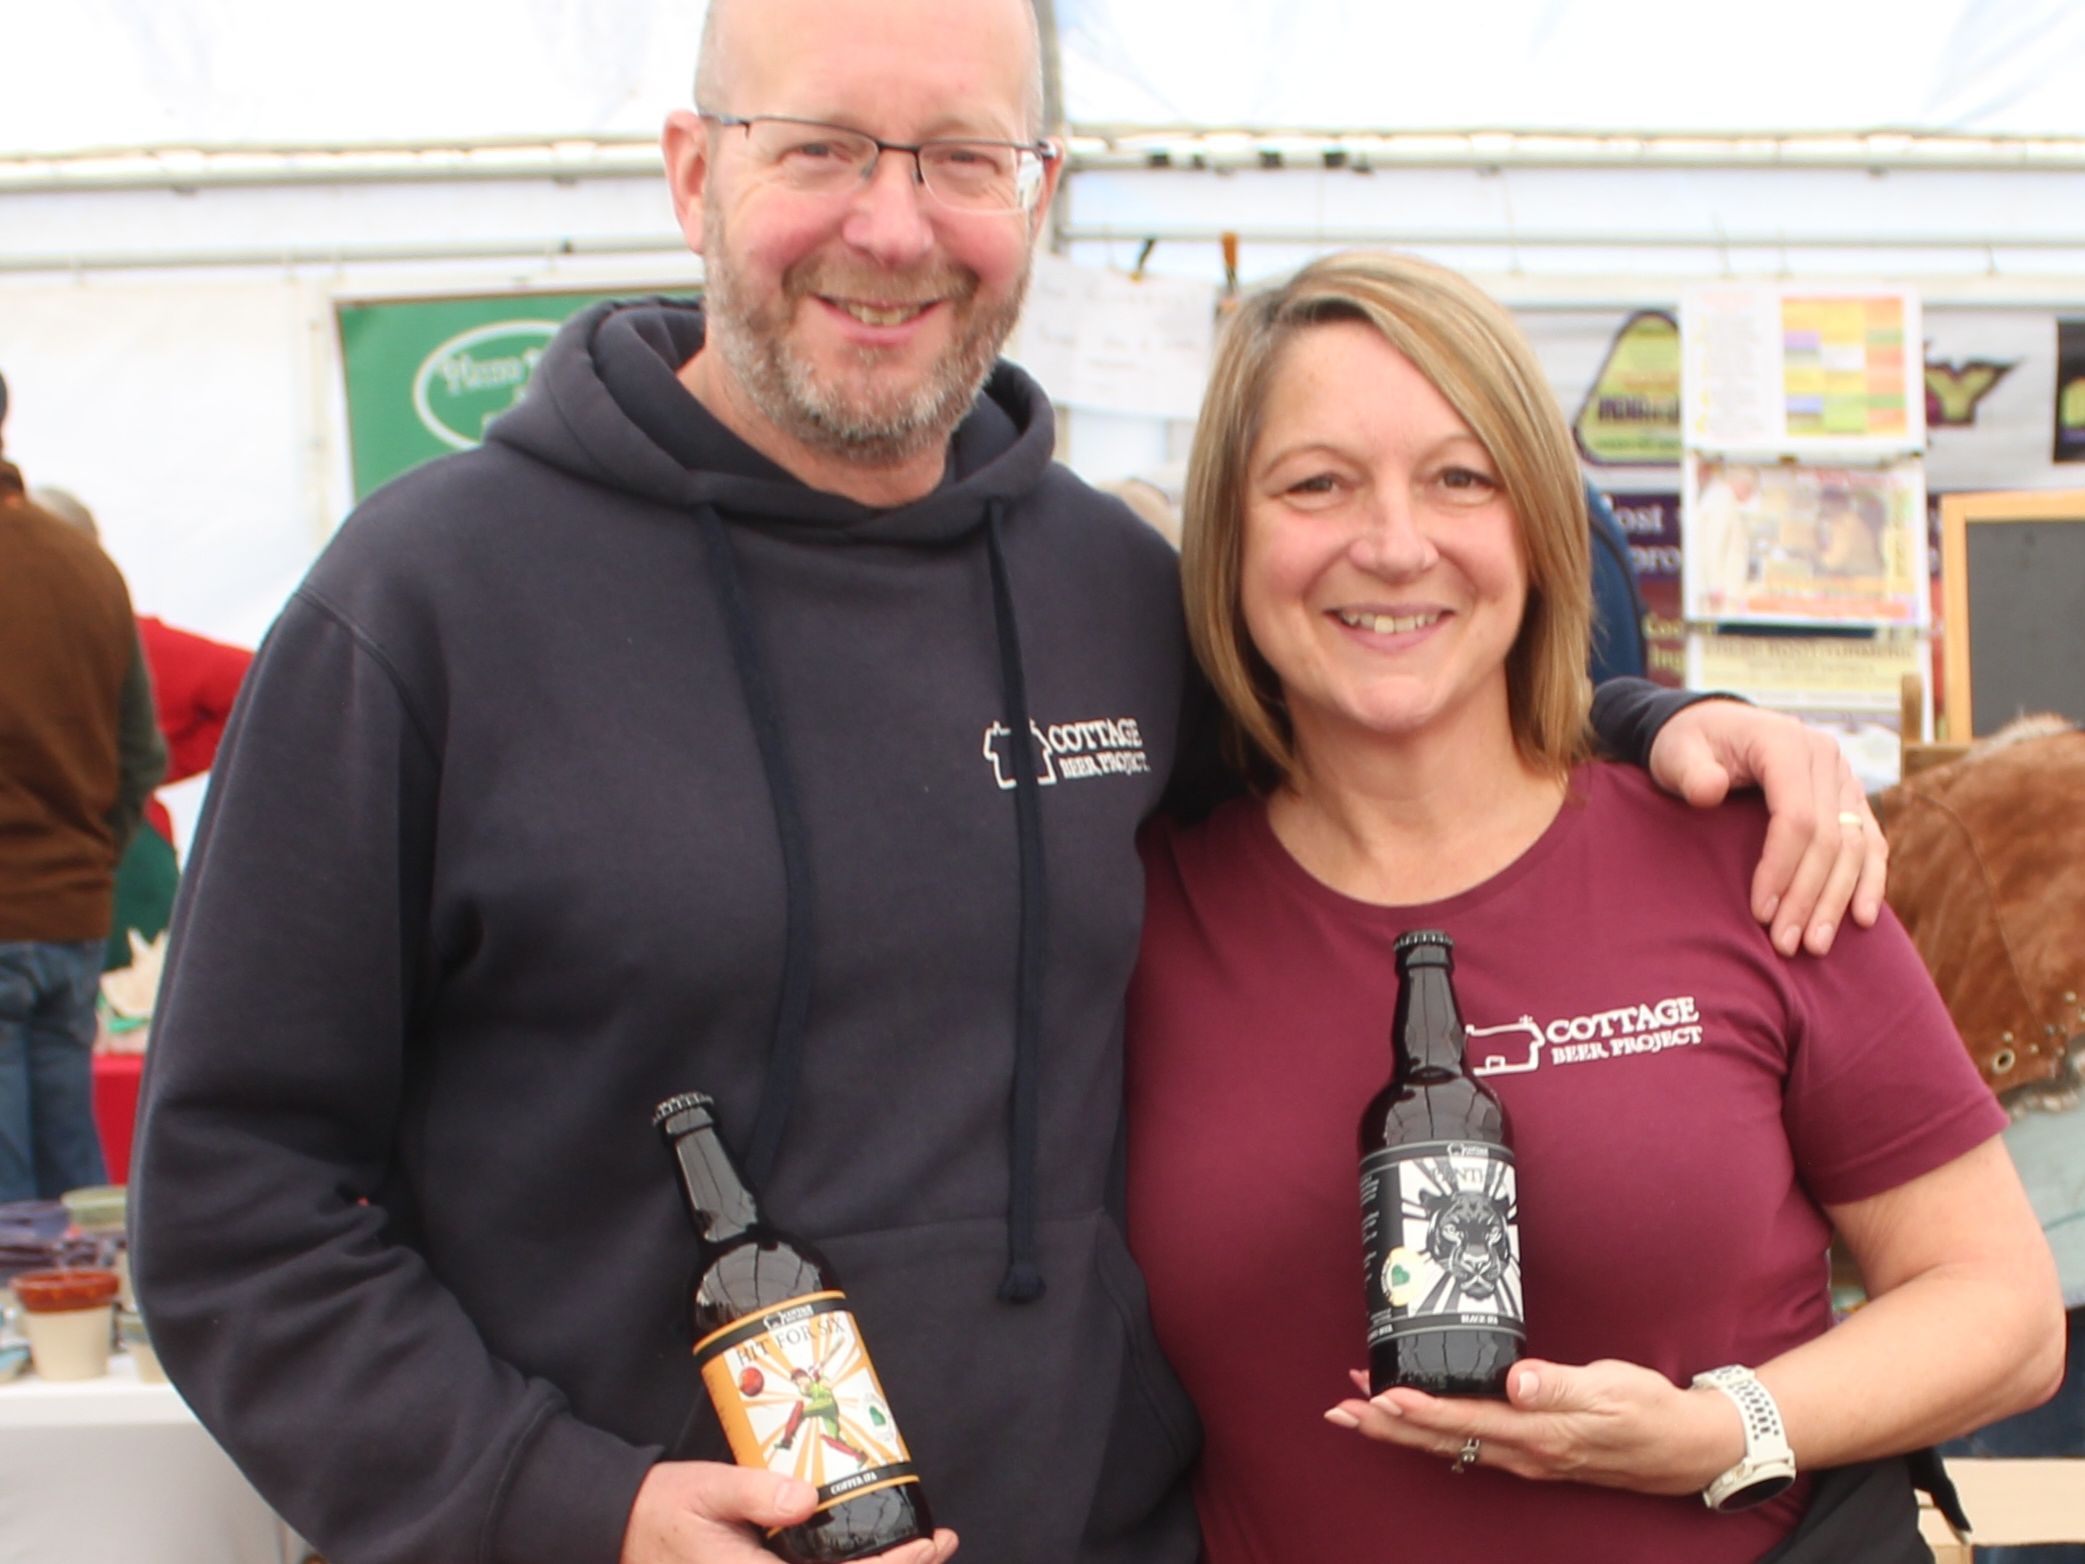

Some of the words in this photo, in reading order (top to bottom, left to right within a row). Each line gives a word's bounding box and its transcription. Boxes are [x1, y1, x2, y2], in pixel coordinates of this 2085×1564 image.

[1049, 717, 1143, 754] COTTAGE
[1060, 755, 1102, 779] BEER
[1097, 751, 1150, 776] PROJECT
[1546, 997, 1700, 1043] COTTAGE
[1551, 1043, 1608, 1065] BEER
[1610, 1026, 1702, 1057] PROJECT
[736, 1340, 769, 1366] HIT
[774, 1324, 817, 1349] FOR
[817, 1315, 846, 1337] SIX
